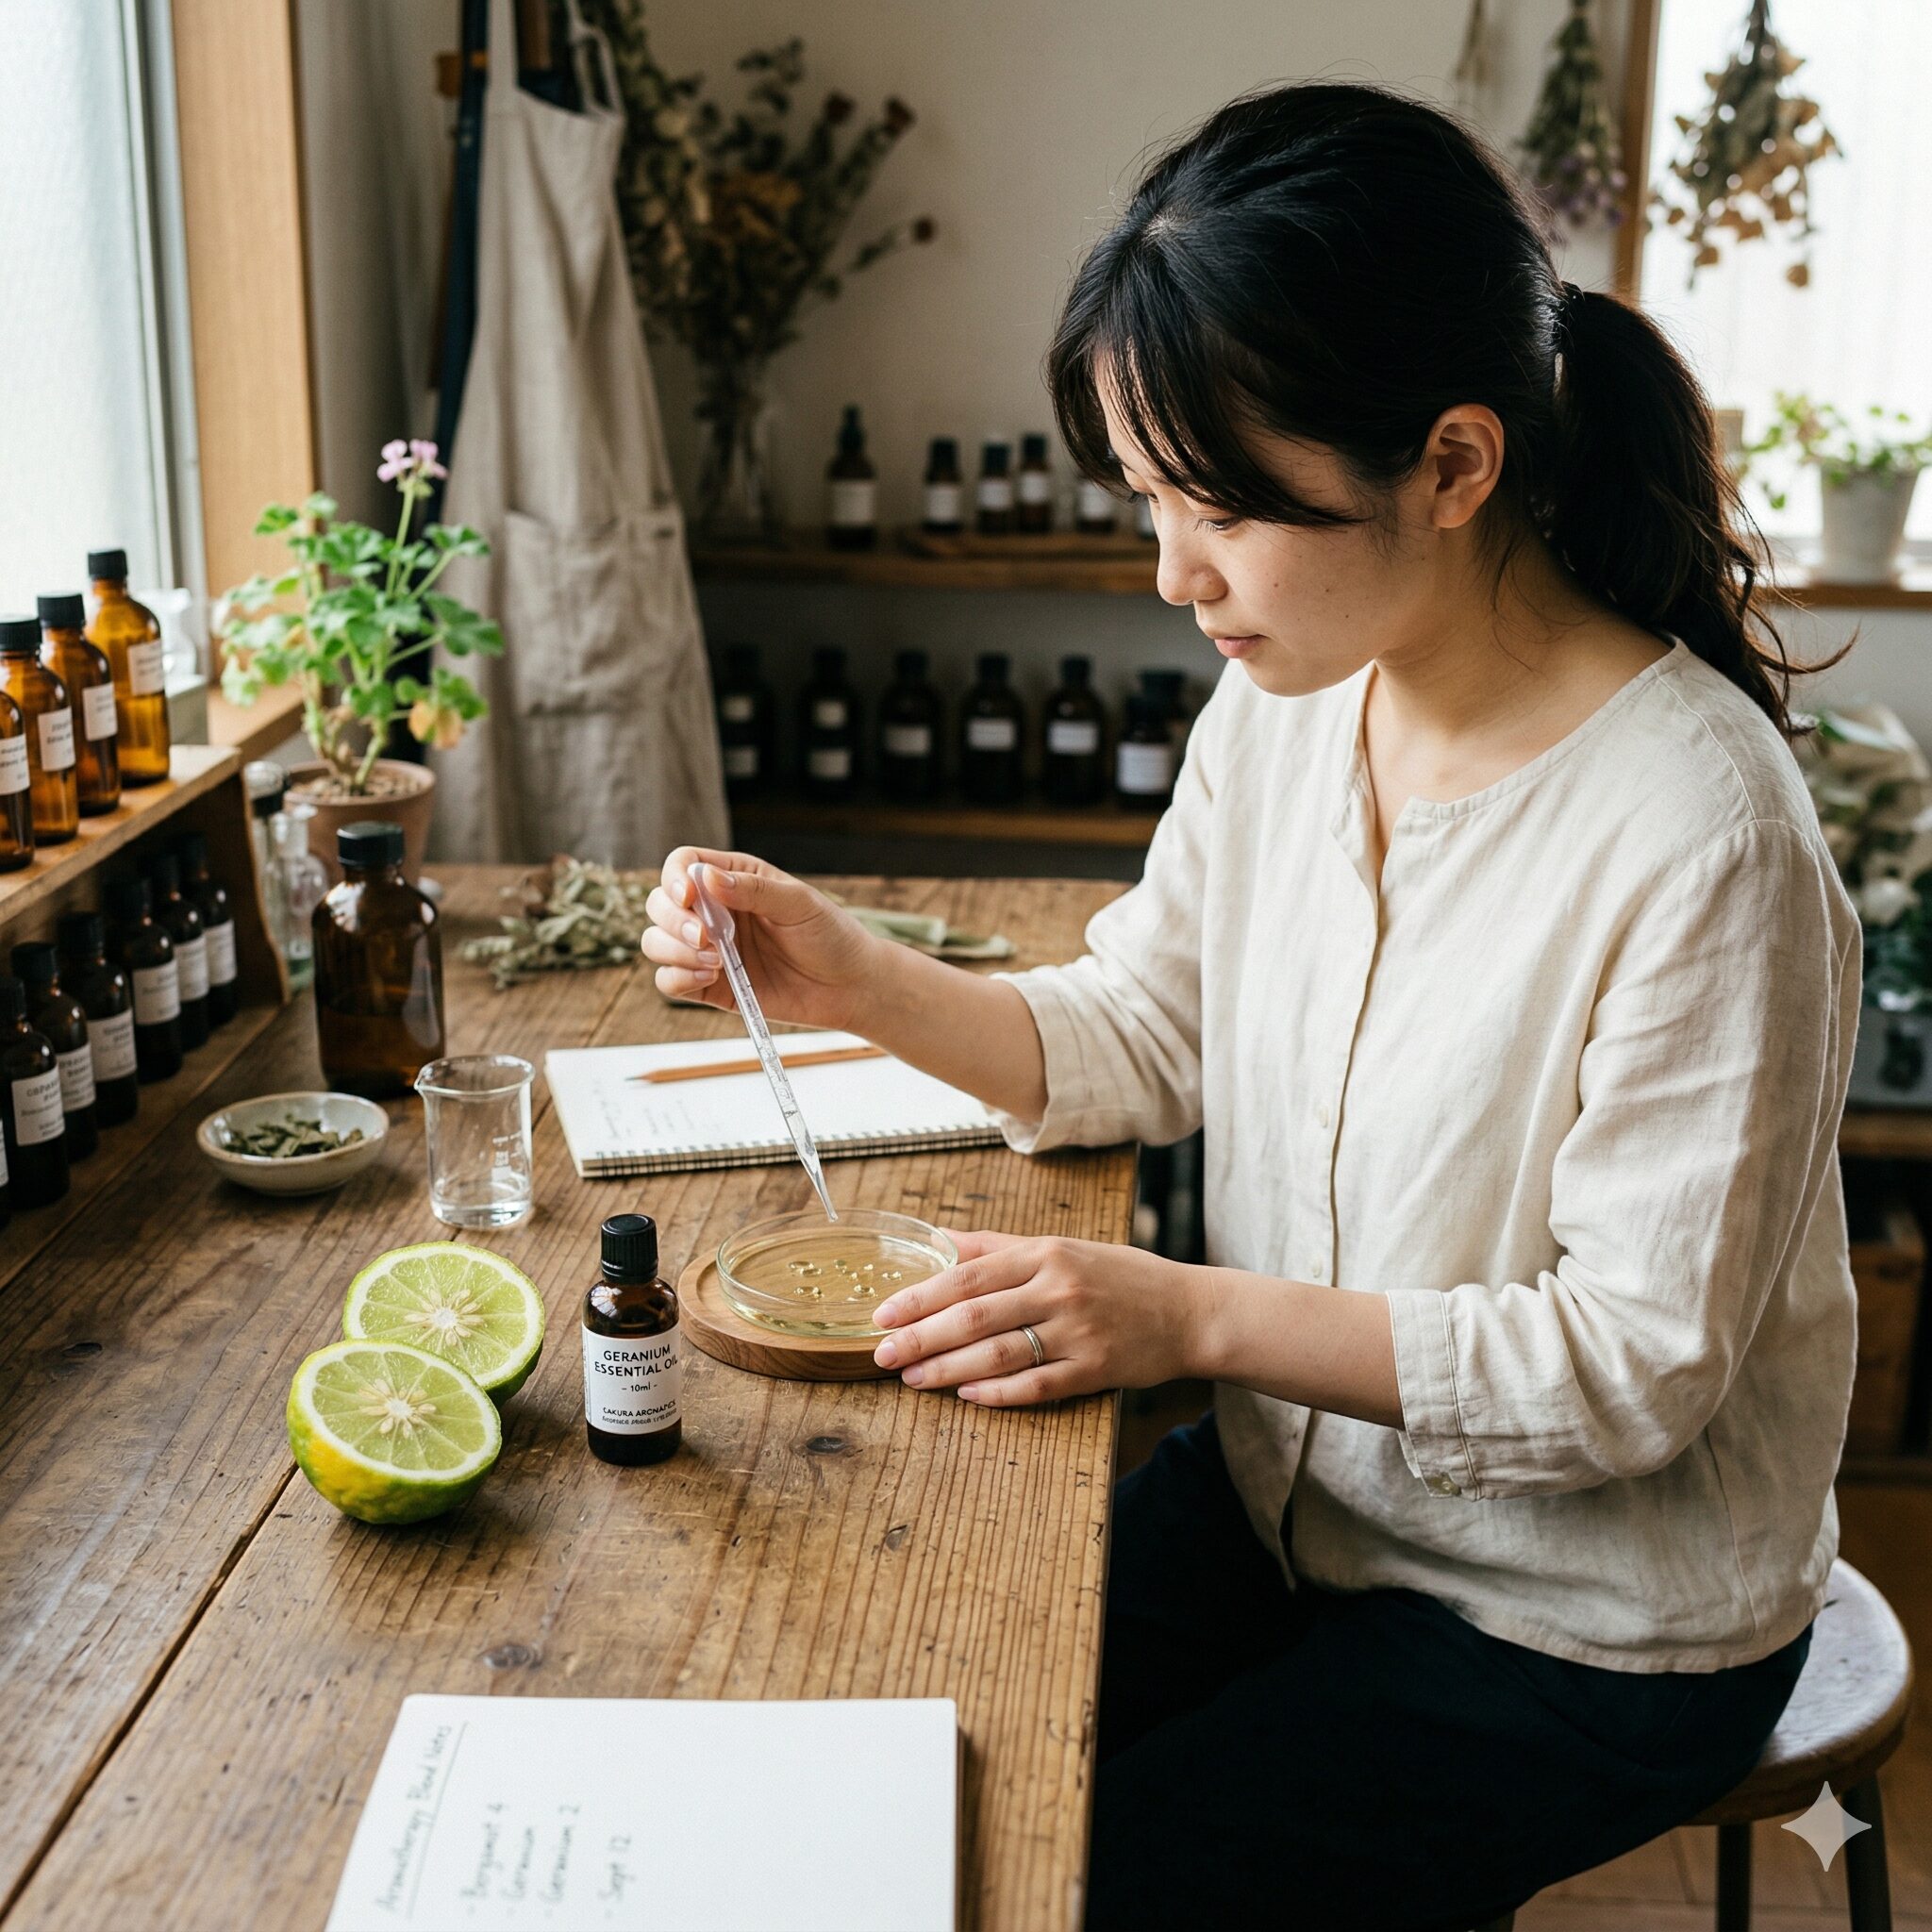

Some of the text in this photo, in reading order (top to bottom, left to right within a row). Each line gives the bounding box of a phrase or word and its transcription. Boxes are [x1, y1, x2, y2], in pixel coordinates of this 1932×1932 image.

[603, 1343, 671, 1362] GERANIUM
[594, 1354, 678, 1376] ESSENTIAL OIL
[630, 1382, 651, 1392] 10ml
